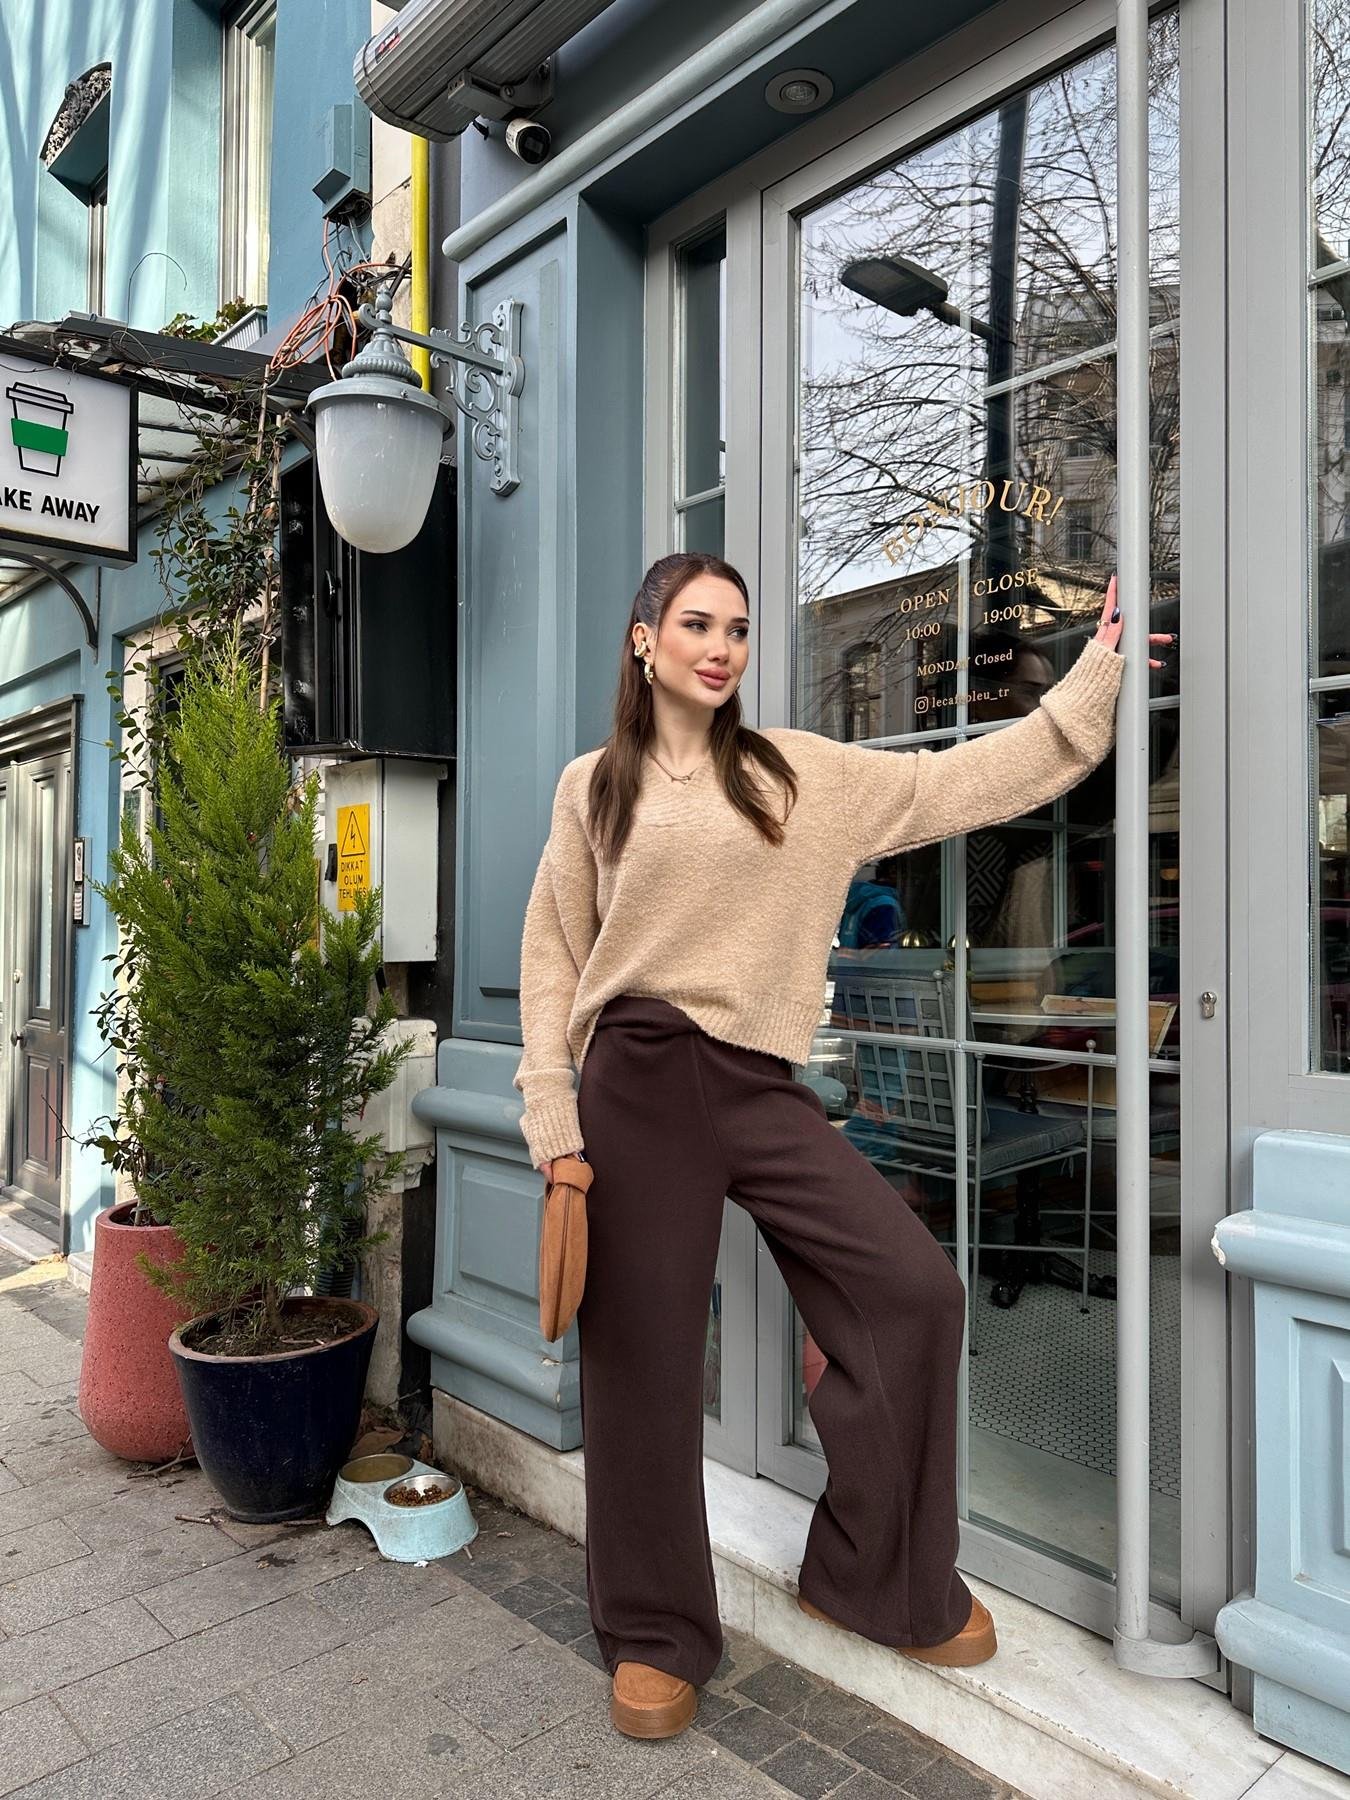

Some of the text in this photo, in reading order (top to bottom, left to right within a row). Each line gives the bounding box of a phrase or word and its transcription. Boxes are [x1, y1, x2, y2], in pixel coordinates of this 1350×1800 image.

[0, 486, 100, 524] KE AWAY
[882, 480, 1064, 567] BONJOUR!
[900, 567, 1039, 614] OPEN CLOSE
[905, 604, 1023, 641] 10:00 19:00
[974, 648, 1014, 666] Closed
